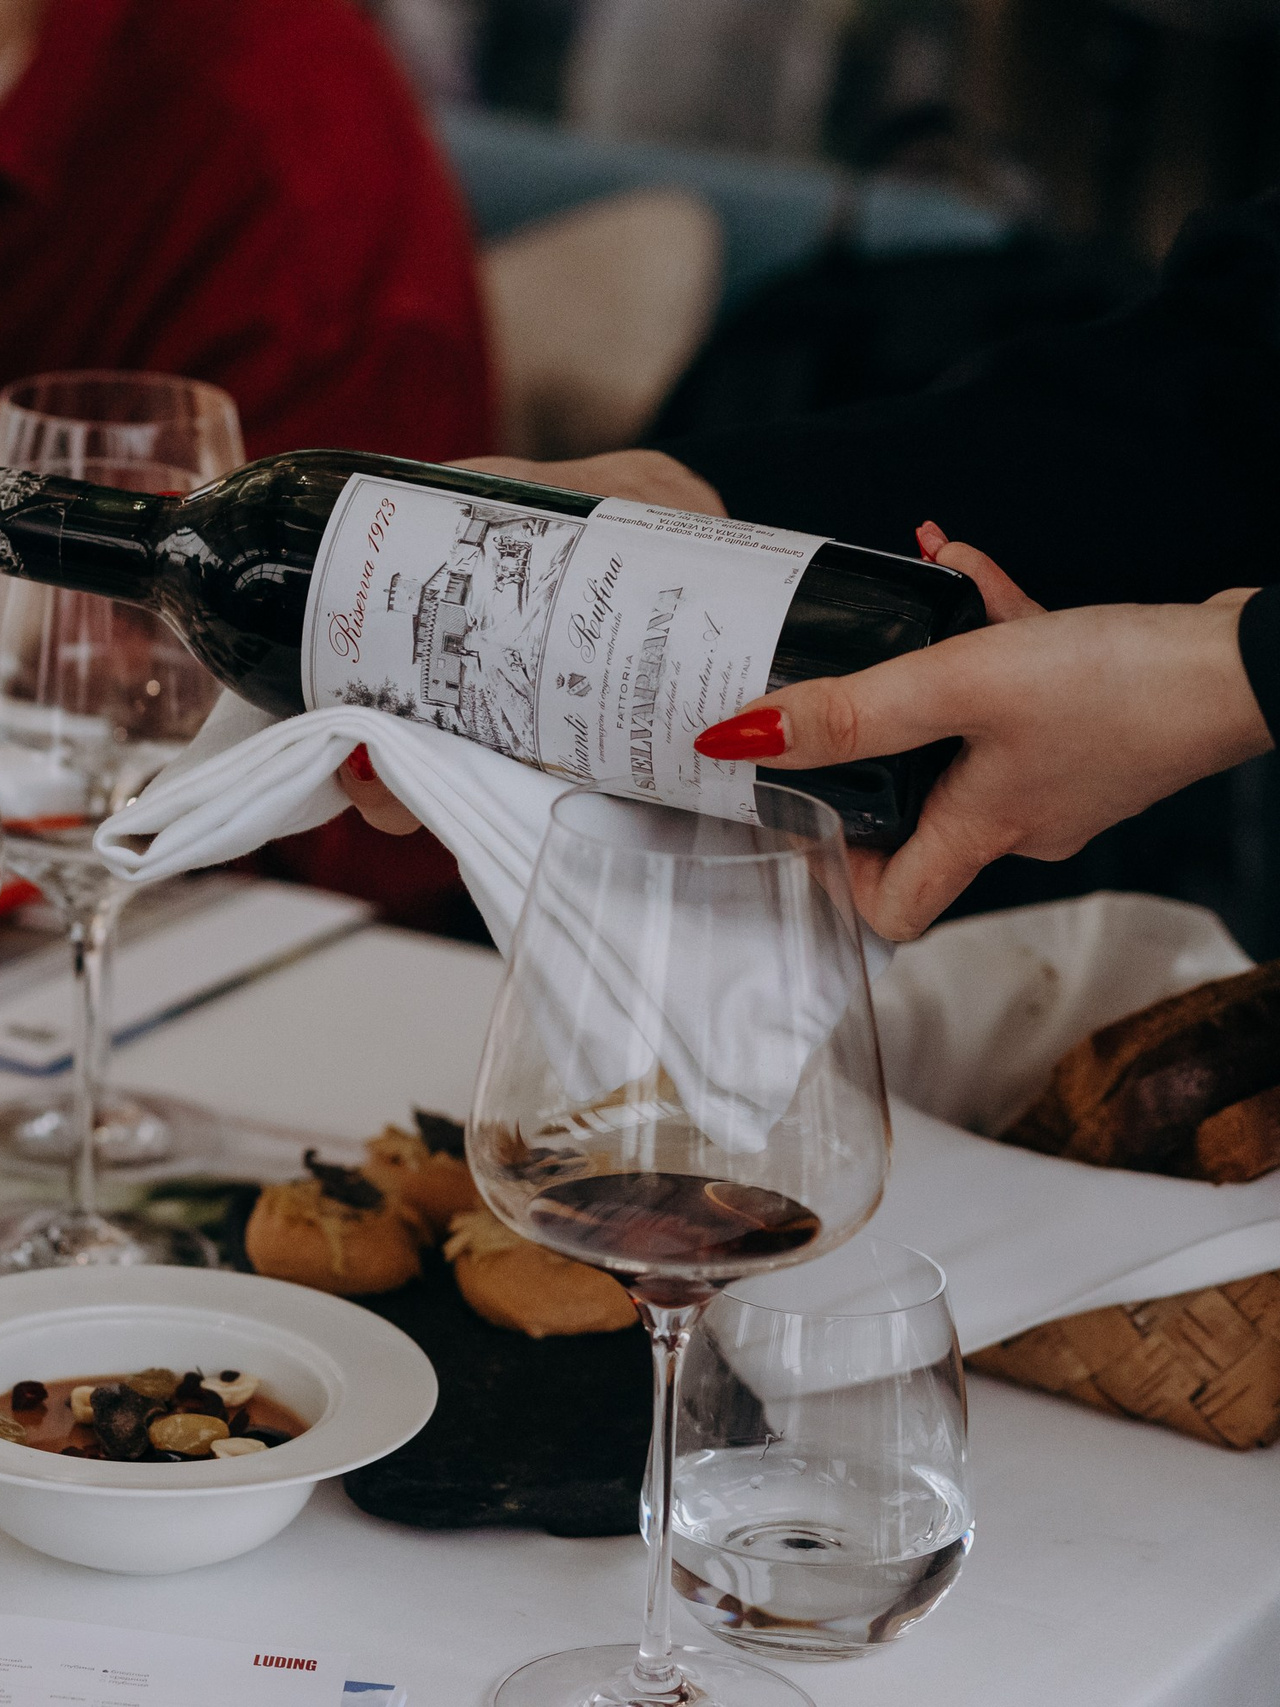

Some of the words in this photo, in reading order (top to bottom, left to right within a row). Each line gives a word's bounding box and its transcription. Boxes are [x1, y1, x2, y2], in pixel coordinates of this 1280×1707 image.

[646, 508, 676, 518] tasting
[596, 513, 653, 531] Degustazione
[659, 517, 699, 532] VENDITA
[702, 525, 714, 533] LA
[722, 523, 754, 533] sample
[666, 526, 692, 537] scopo
[694, 531, 712, 540] solo
[714, 534, 723, 542] al
[716, 528, 752, 541] VIETATA
[754, 528, 776, 537] Free
[725, 535, 759, 549] gratuito
[760, 543, 804, 558] Campione
[329, 560, 375, 663] Riserva
[367, 498, 396, 553] 1973
[568, 551, 624, 664] Rufina
[606, 611, 623, 666] controllata
[739, 655, 752, 679] ITALIA
[601, 671, 613, 699] origine
[617, 654, 633, 729] FATTORIA
[666, 680, 679, 744] imbottigliato
[673, 660, 682, 675] da
[682, 658, 715, 733] Giuntini
[253, 1654, 318, 1672] LUDING
